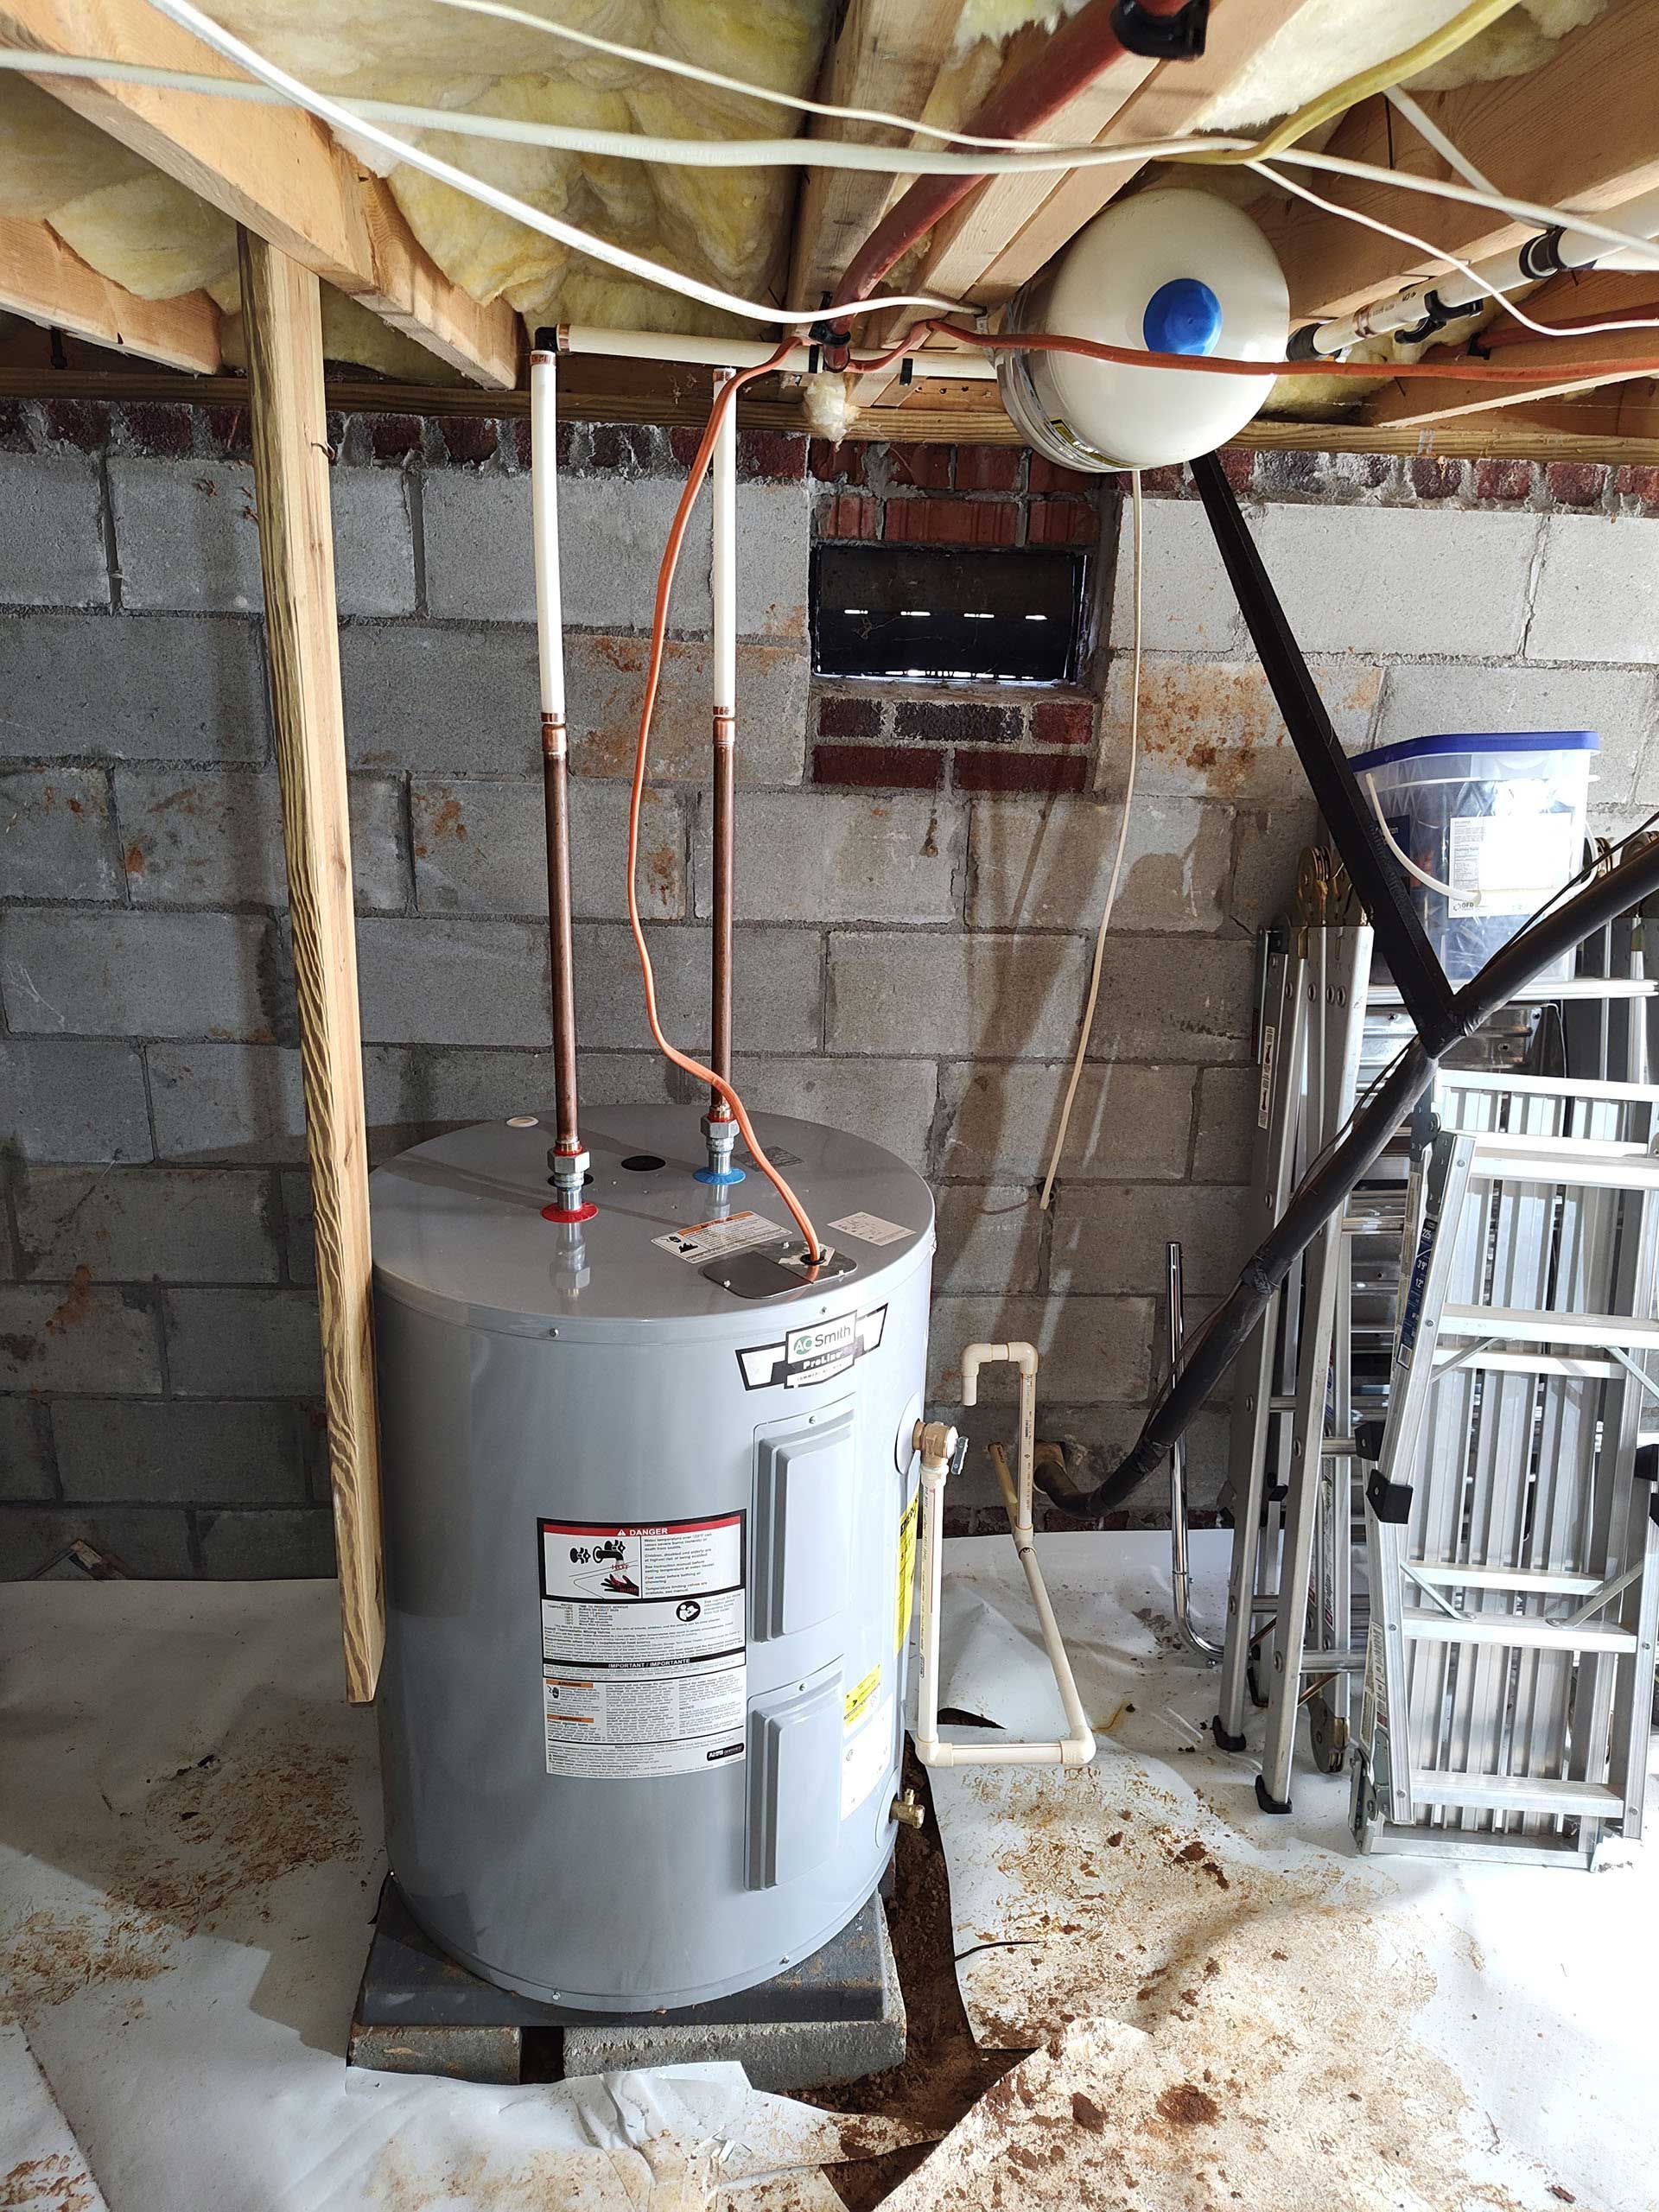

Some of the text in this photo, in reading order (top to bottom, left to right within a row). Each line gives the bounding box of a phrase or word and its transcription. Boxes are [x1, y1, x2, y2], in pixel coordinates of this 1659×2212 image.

[815, 1325, 851, 1347] Smith
[629, 1528, 668, 1536] DANGER
[650, 1658, 690, 1667] IMPORTANTE
